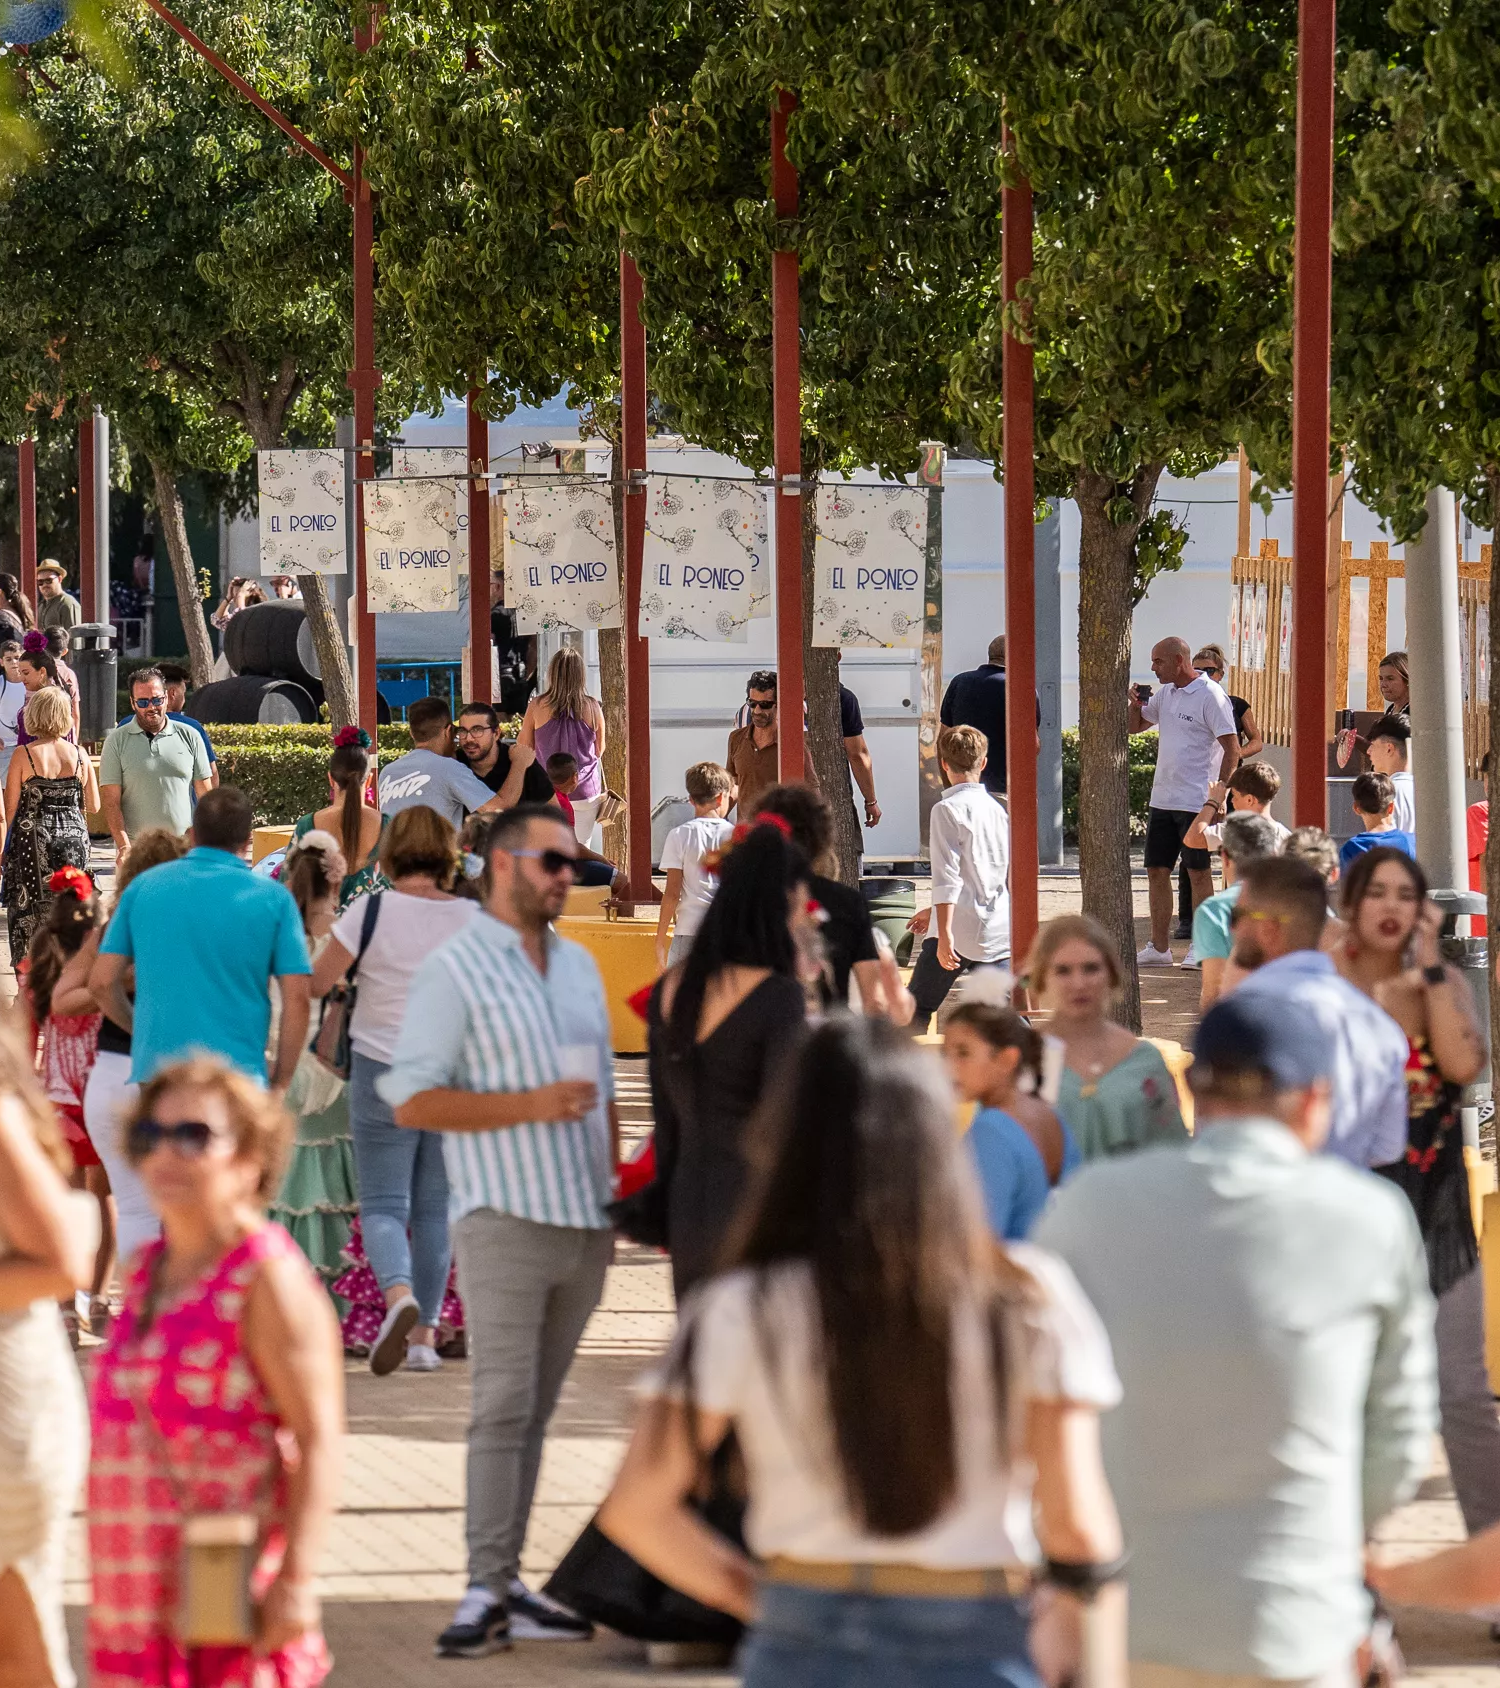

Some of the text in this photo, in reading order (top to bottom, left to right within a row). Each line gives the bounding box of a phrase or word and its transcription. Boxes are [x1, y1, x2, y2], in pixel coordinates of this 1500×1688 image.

[271, 514, 337, 533] EL RONEO
[380, 549, 451, 570] EL RONEO
[529, 562, 607, 587] EL RONEO
[659, 563, 745, 591] EL RONEO
[832, 567, 919, 591] EL RONEO
